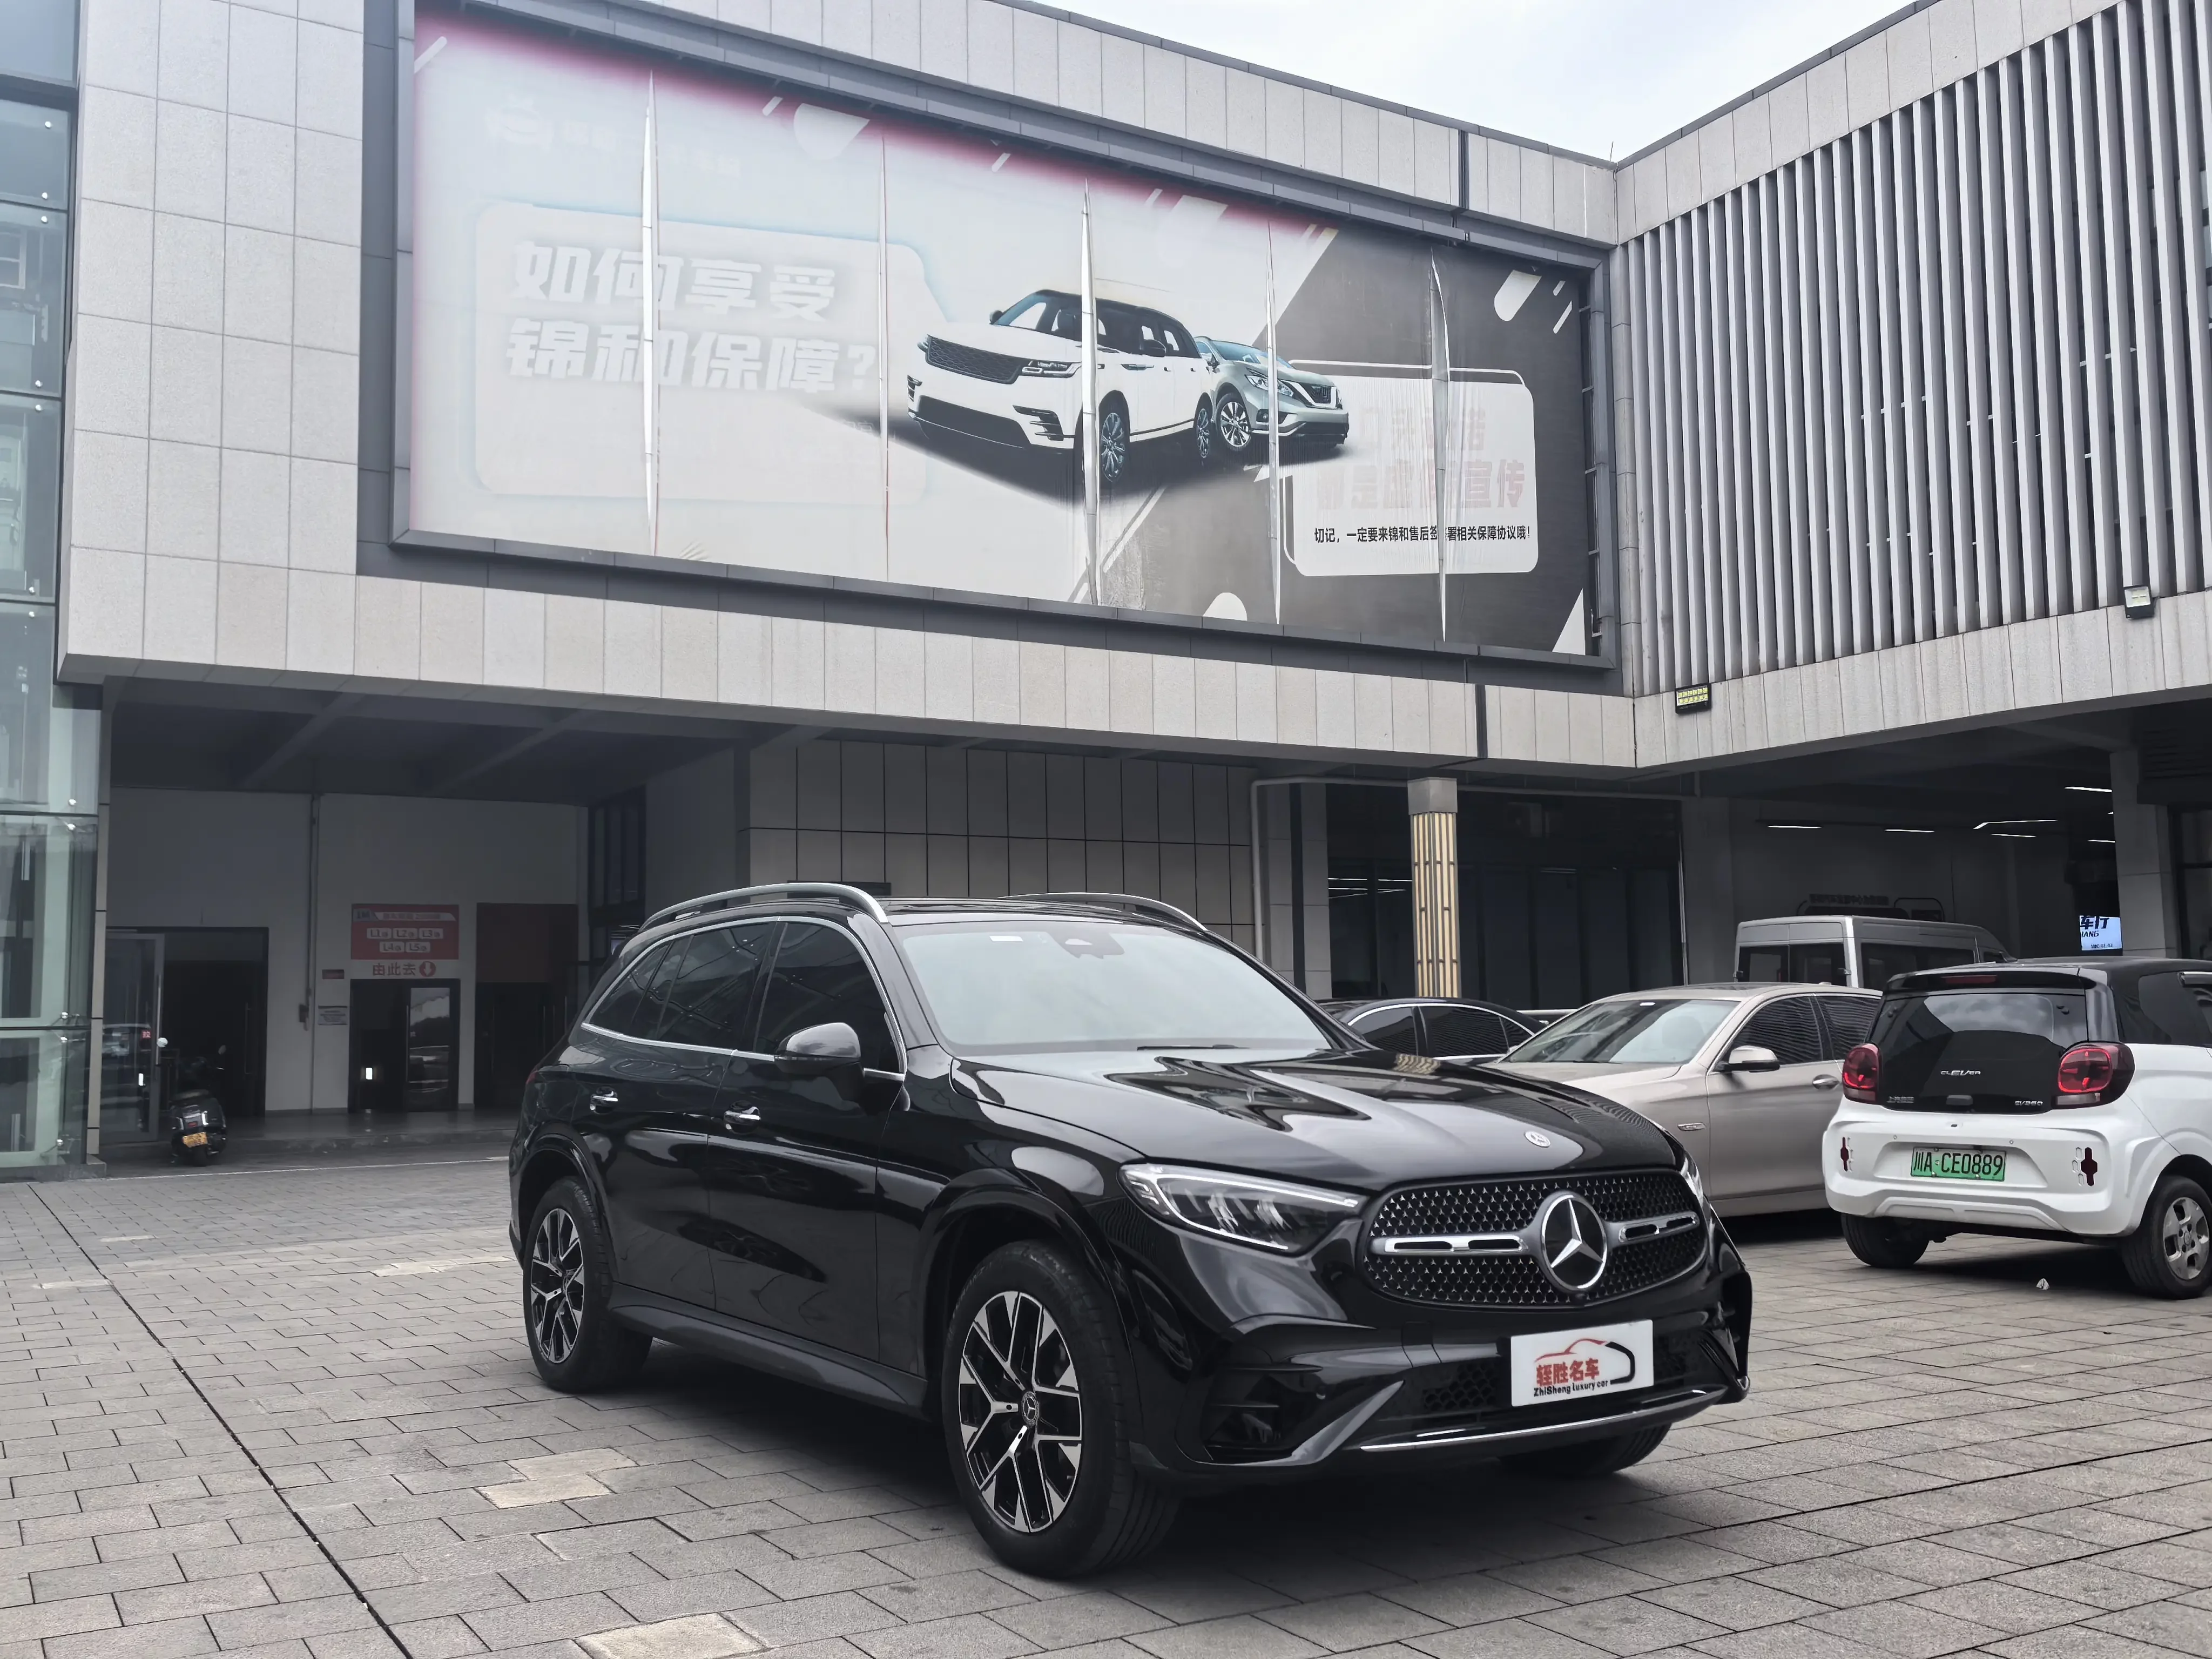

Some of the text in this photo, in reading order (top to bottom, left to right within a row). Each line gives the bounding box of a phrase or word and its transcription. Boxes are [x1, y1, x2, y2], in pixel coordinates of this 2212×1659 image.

[512, 245, 836, 322] 如何享受
[373, 962, 416, 976] 由此去
[1573, 1382, 1595, 1392] luxury
[1597, 1380, 1608, 1388] car
